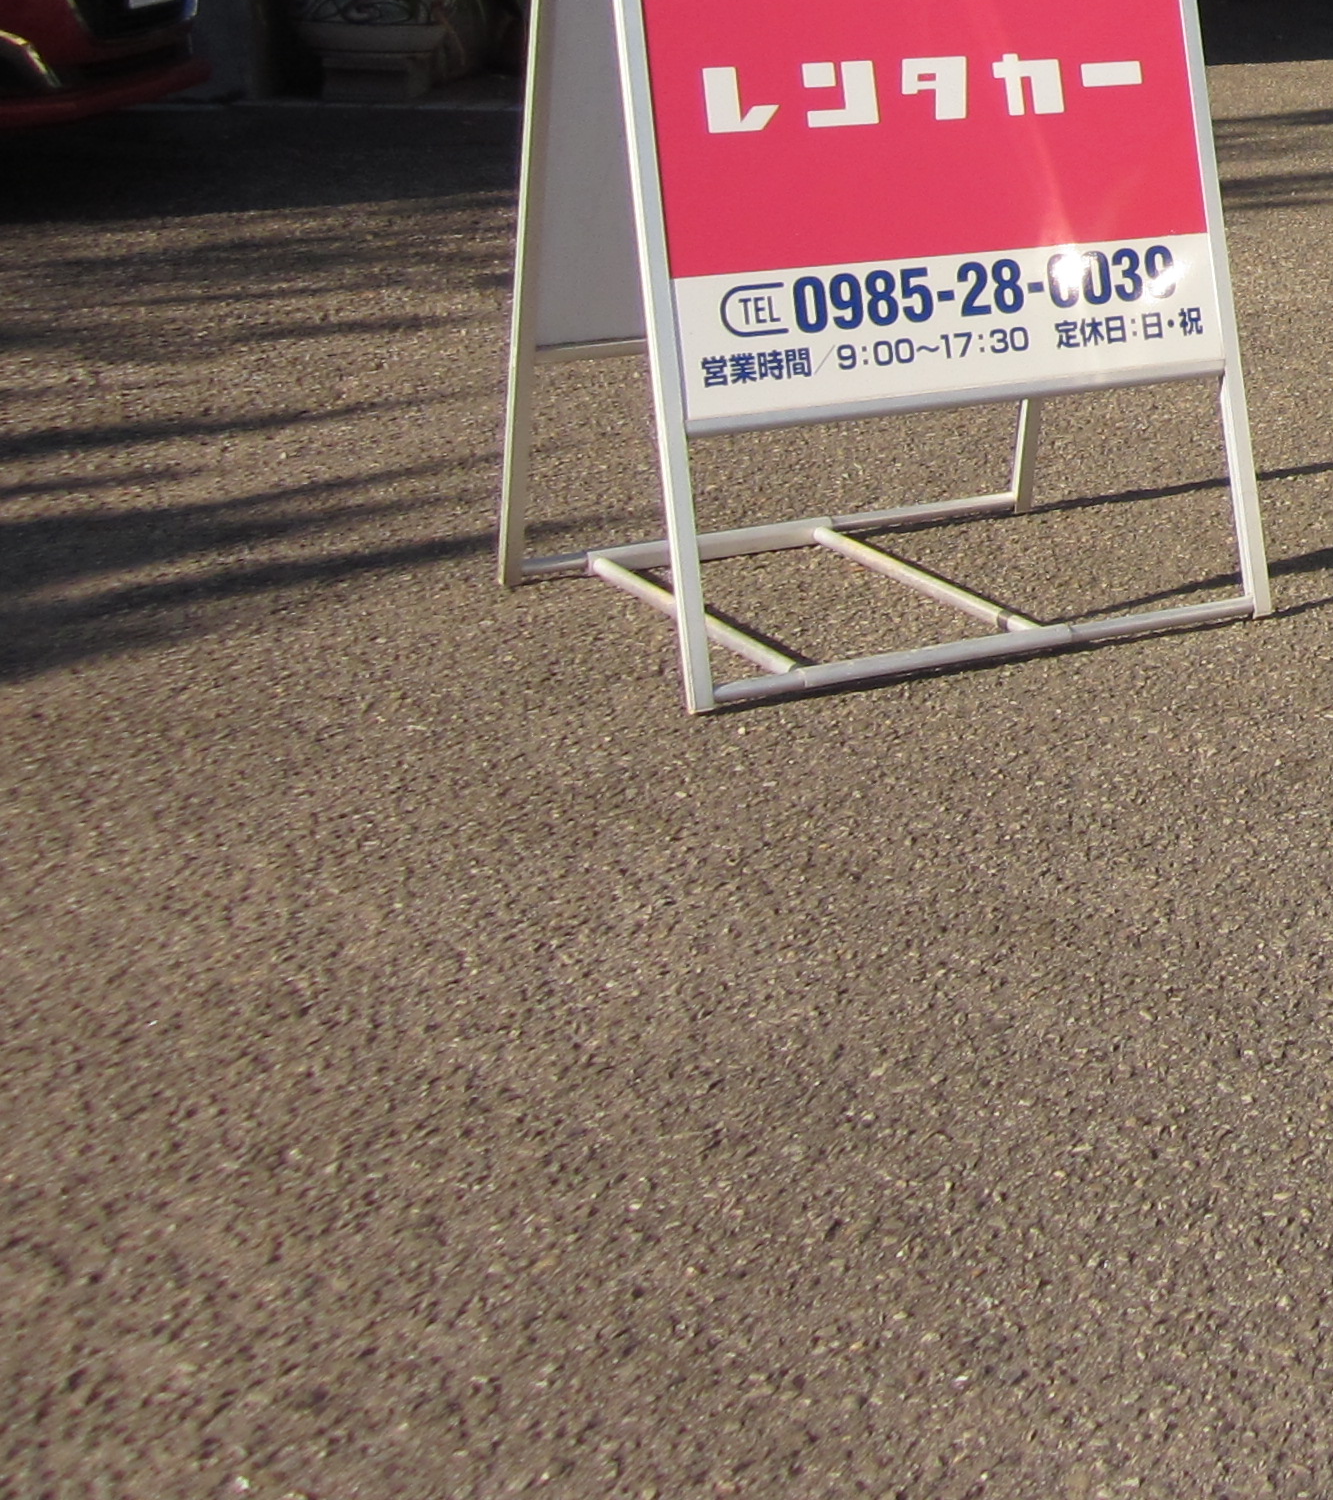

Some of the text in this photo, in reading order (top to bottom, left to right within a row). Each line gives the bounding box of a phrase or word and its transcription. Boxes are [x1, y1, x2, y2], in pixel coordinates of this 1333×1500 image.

[701, 53, 1143, 134] レンタカー
[738, 295, 781, 326] TEL
